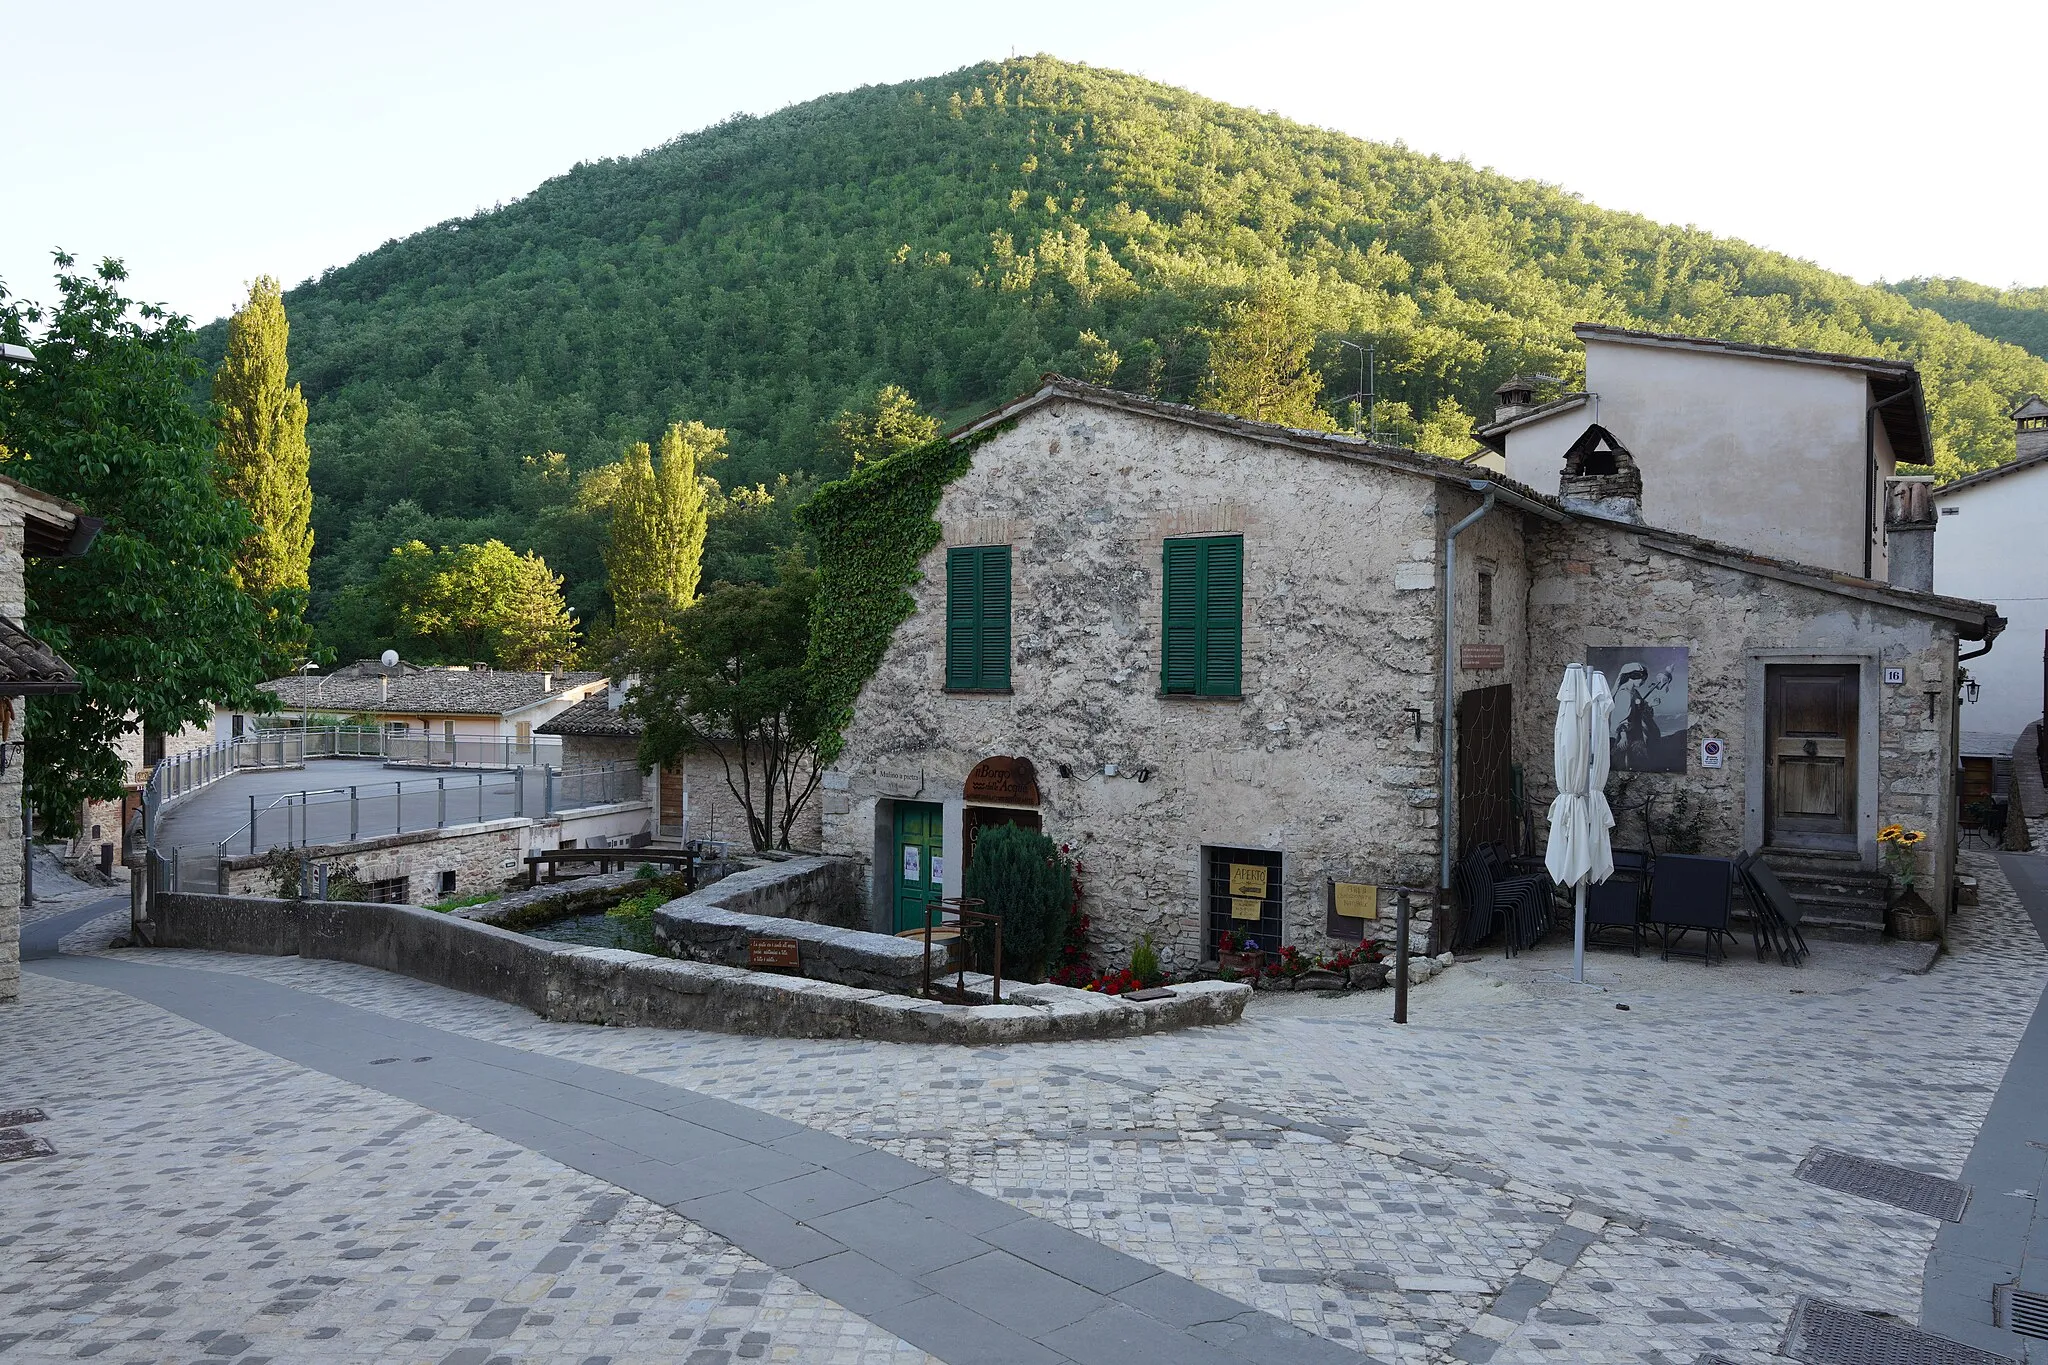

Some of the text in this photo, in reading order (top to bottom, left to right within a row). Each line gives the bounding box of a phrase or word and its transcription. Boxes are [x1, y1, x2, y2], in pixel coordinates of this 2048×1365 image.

[1889, 671, 1900, 680] 16
[880, 770, 899, 779] Mulino
[981, 764, 1011, 783] Borgo
[986, 780, 1028, 797] delle Acque
[1233, 868, 1265, 881] APERTO
